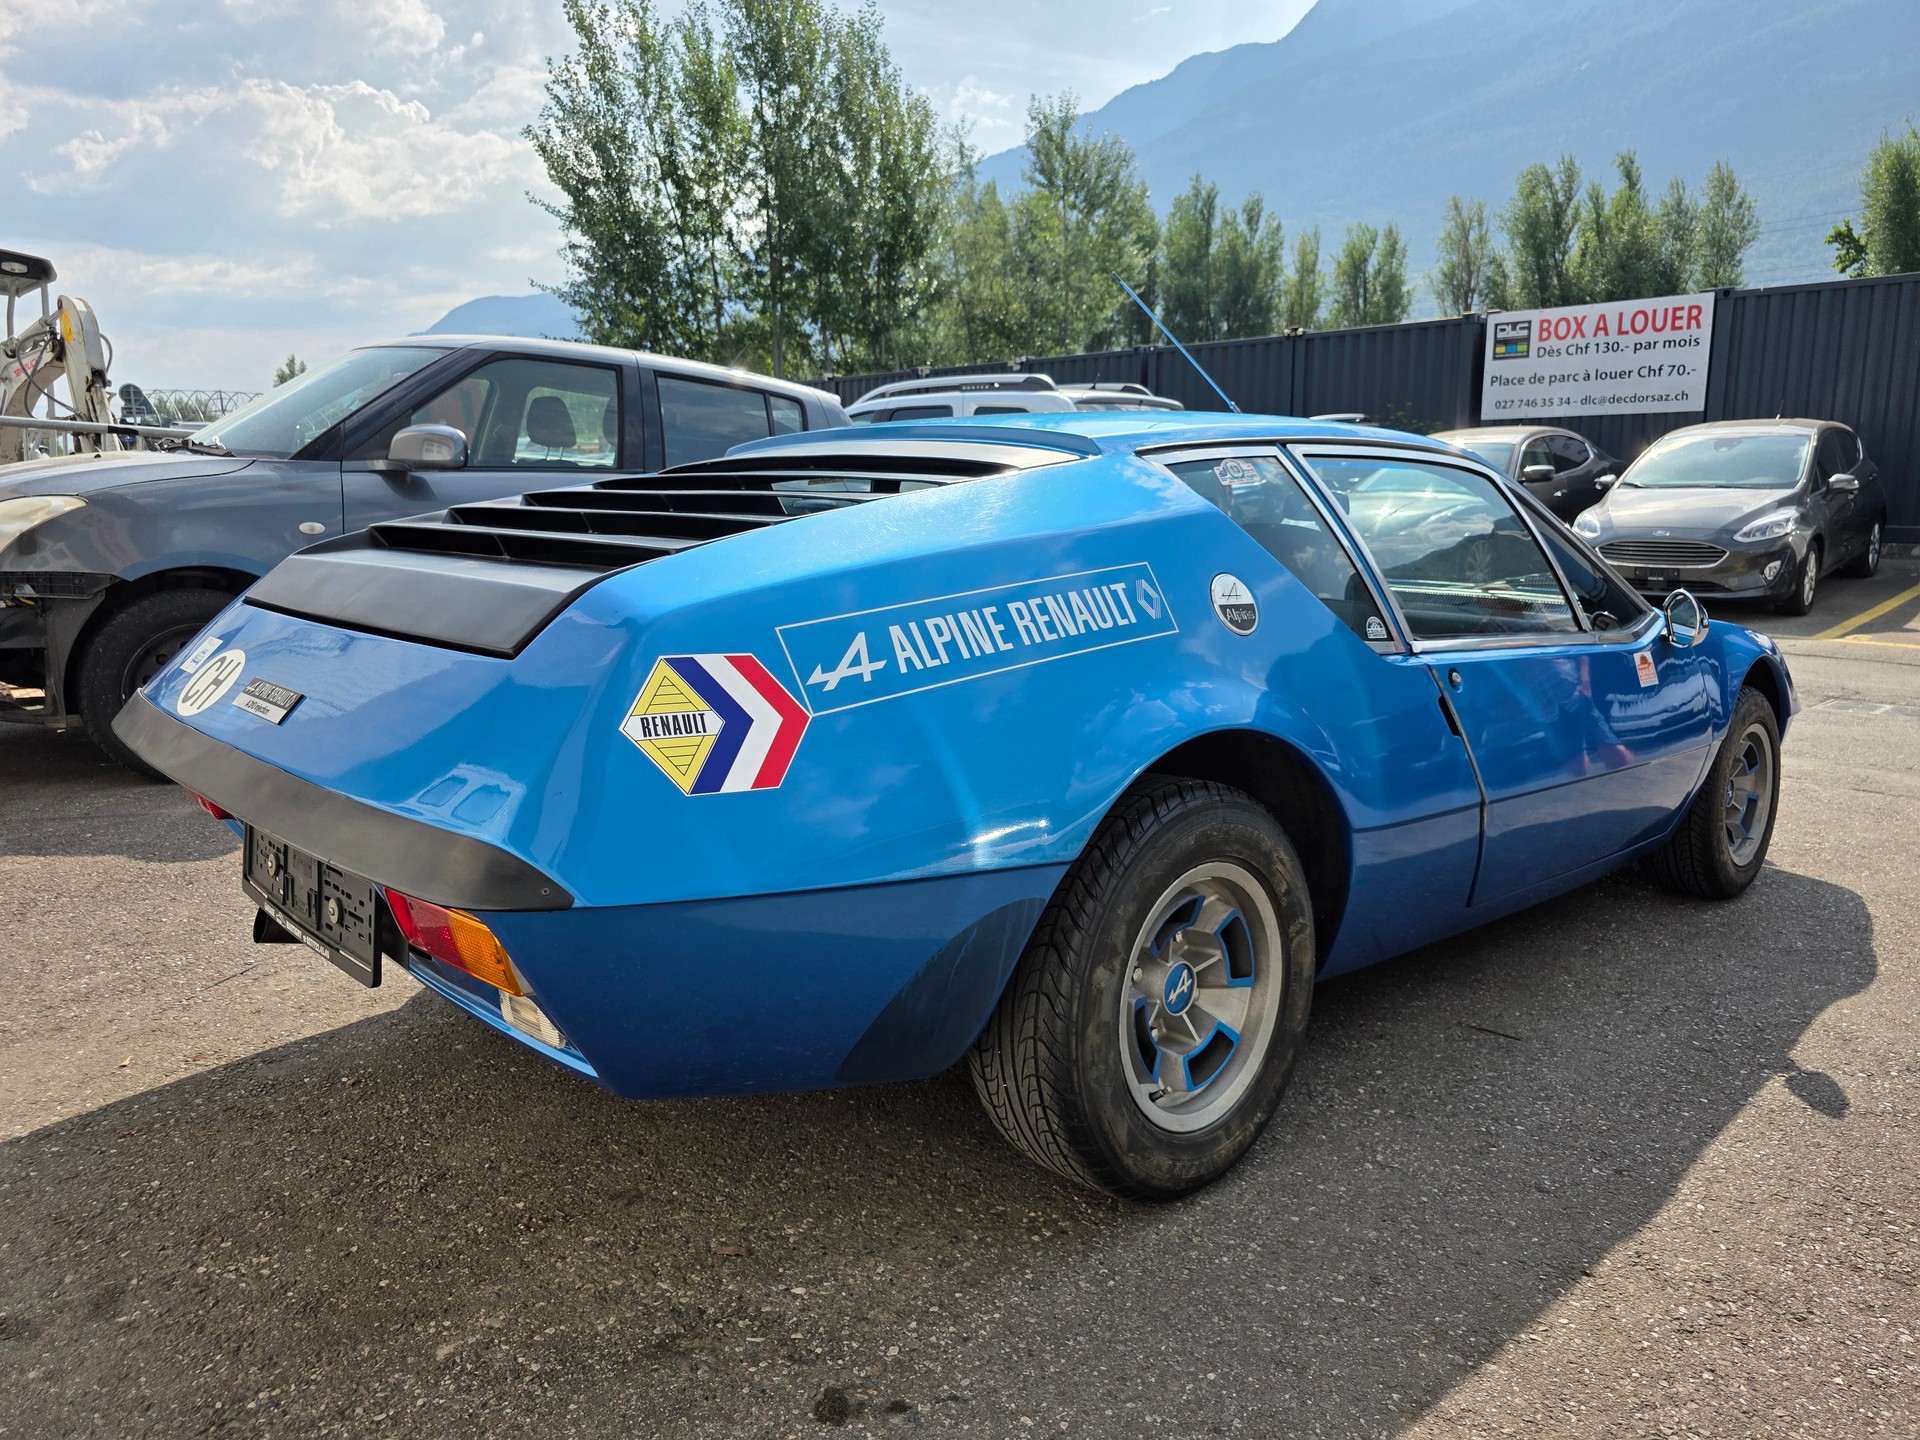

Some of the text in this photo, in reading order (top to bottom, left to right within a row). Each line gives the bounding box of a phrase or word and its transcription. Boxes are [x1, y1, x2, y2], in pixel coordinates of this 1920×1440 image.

[1496, 322, 1529, 338] DLC
[1538, 305, 1703, 342] BOX A LOUER
[1537, 345, 1562, 359] Dès
[1565, 342, 1591, 356] Chf
[1594, 341, 1630, 354] 130.-
[1633, 340, 1659, 354] par
[1662, 334, 1700, 350] mois
[1490, 363, 1697, 387] Place de parc à louer Chf 70.-
[1494, 399, 1515, 410] 027
[1517, 398, 1538, 408] 746
[1540, 397, 1554, 408] 35
[1556, 396, 1571, 407] 34
[1580, 390, 1689, 406] dlc@decdorsaz.ch
[1226, 608, 1256, 623] Alpine
[888, 605, 1014, 675] ALPINE
[1006, 582, 1138, 646] RENAULT
[181, 655, 242, 711] CH
[640, 713, 708, 738] RENAULT
